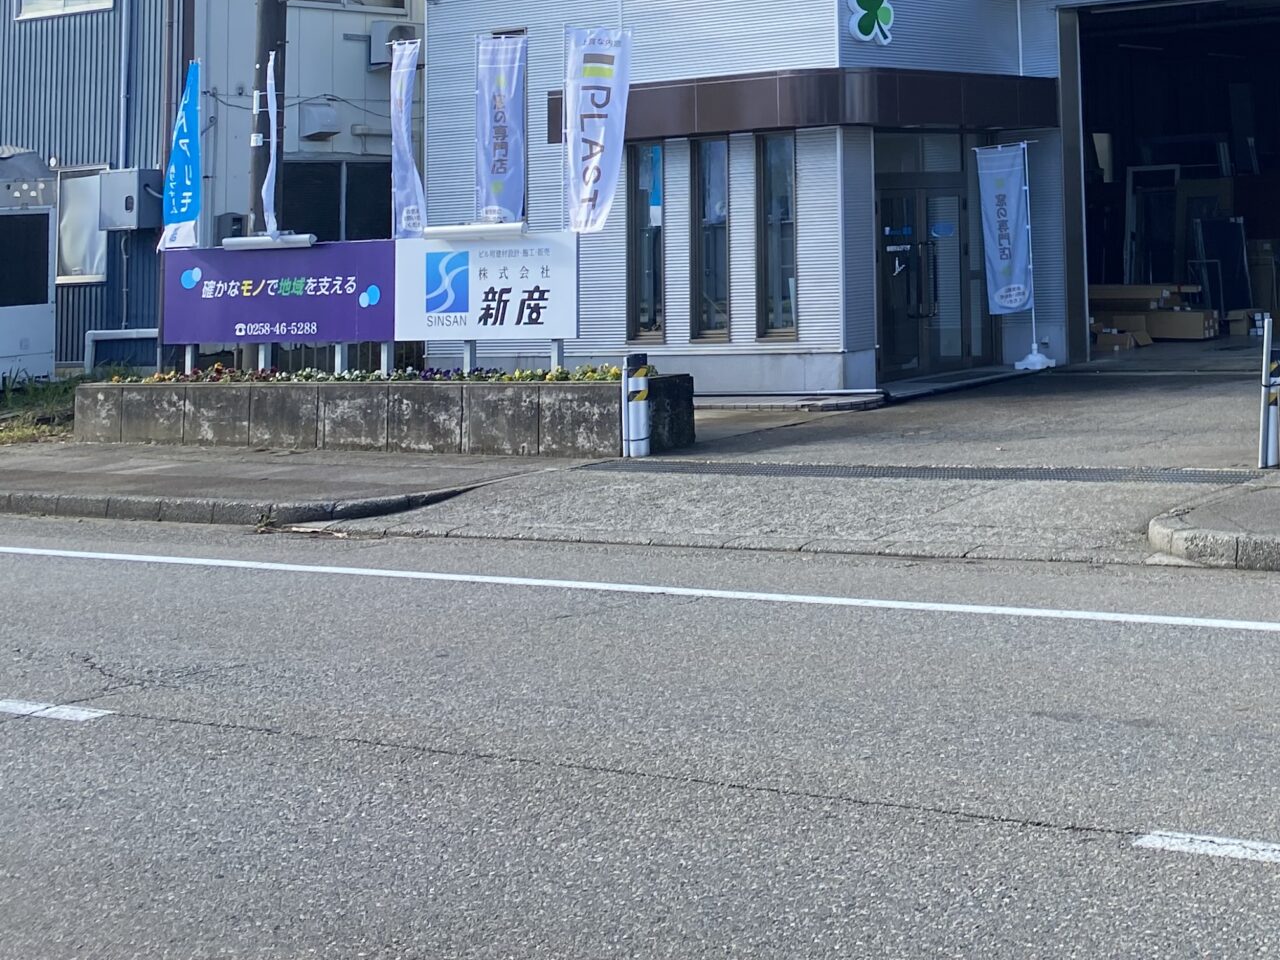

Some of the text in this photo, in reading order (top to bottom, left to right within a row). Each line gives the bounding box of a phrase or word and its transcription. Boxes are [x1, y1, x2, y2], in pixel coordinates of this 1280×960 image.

[580, 85, 611, 210] PLAST
[478, 265, 551, 281] 株式会社
[201, 276, 357, 299] 確かなモノで地域を支える
[477, 285, 551, 326] 新産
[246, 321, 318, 336] 0258-46-5288
[426, 315, 467, 327] SINSAN
